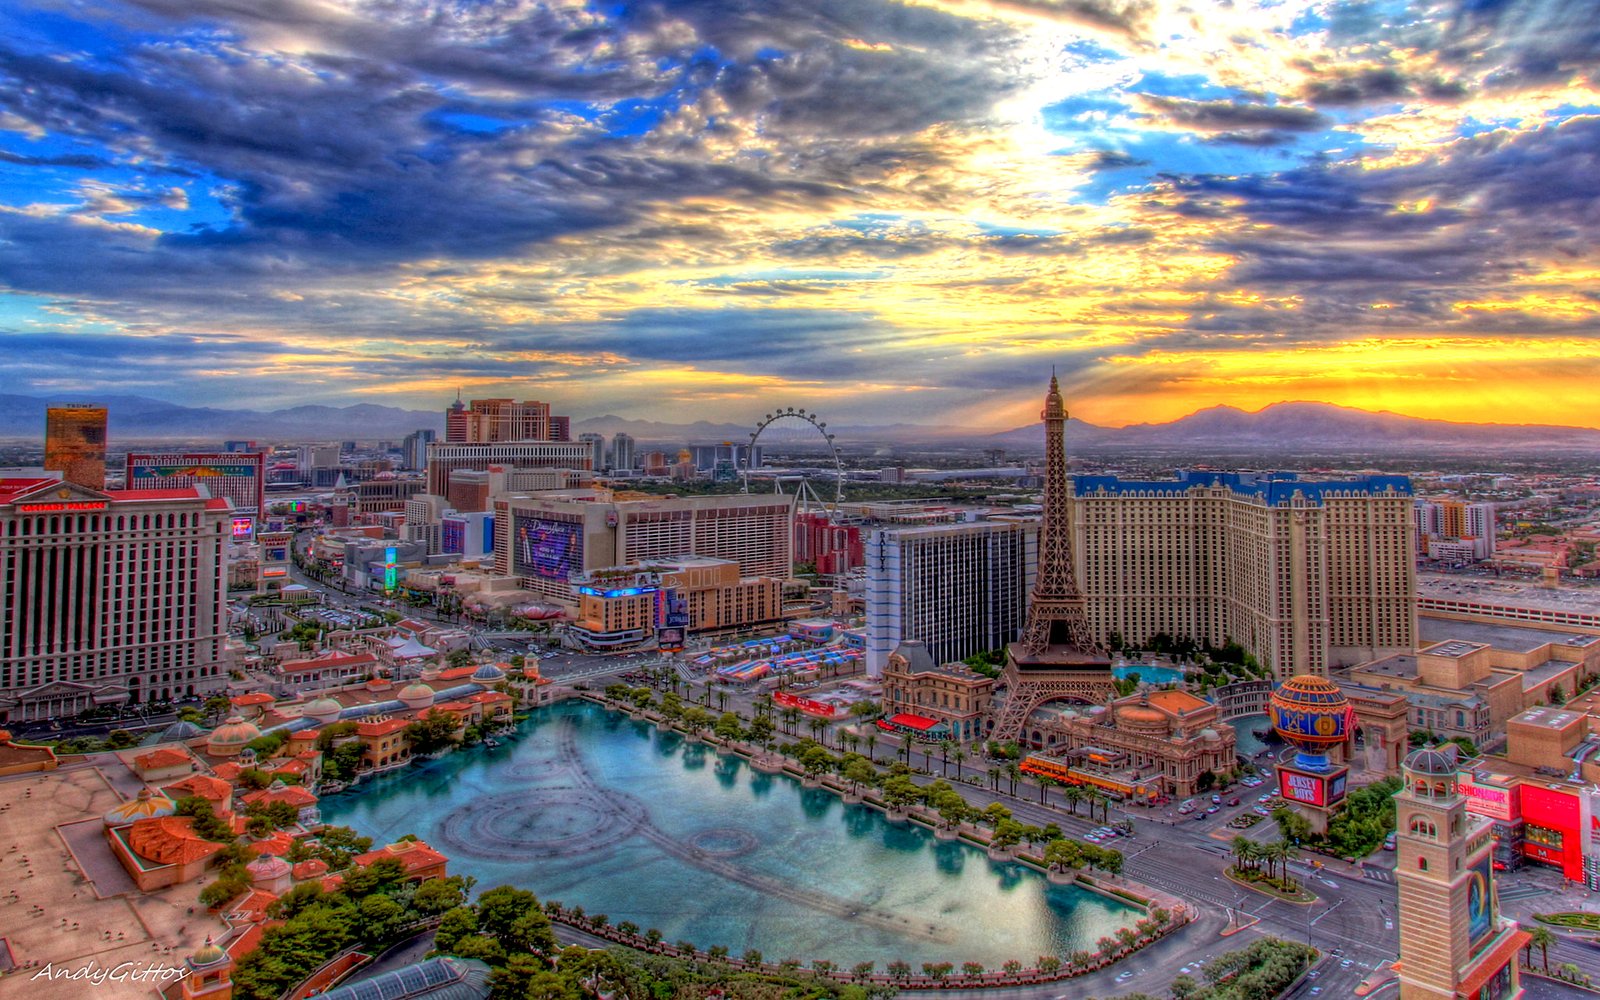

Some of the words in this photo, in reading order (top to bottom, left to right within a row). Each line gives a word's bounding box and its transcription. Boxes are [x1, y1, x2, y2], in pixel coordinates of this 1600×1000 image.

[67, 502, 106, 510] PALACE
[797, 697, 810, 706] CVS
[1288, 775, 1315, 790] JERSEY
[1294, 787, 1314, 801] BOYS
